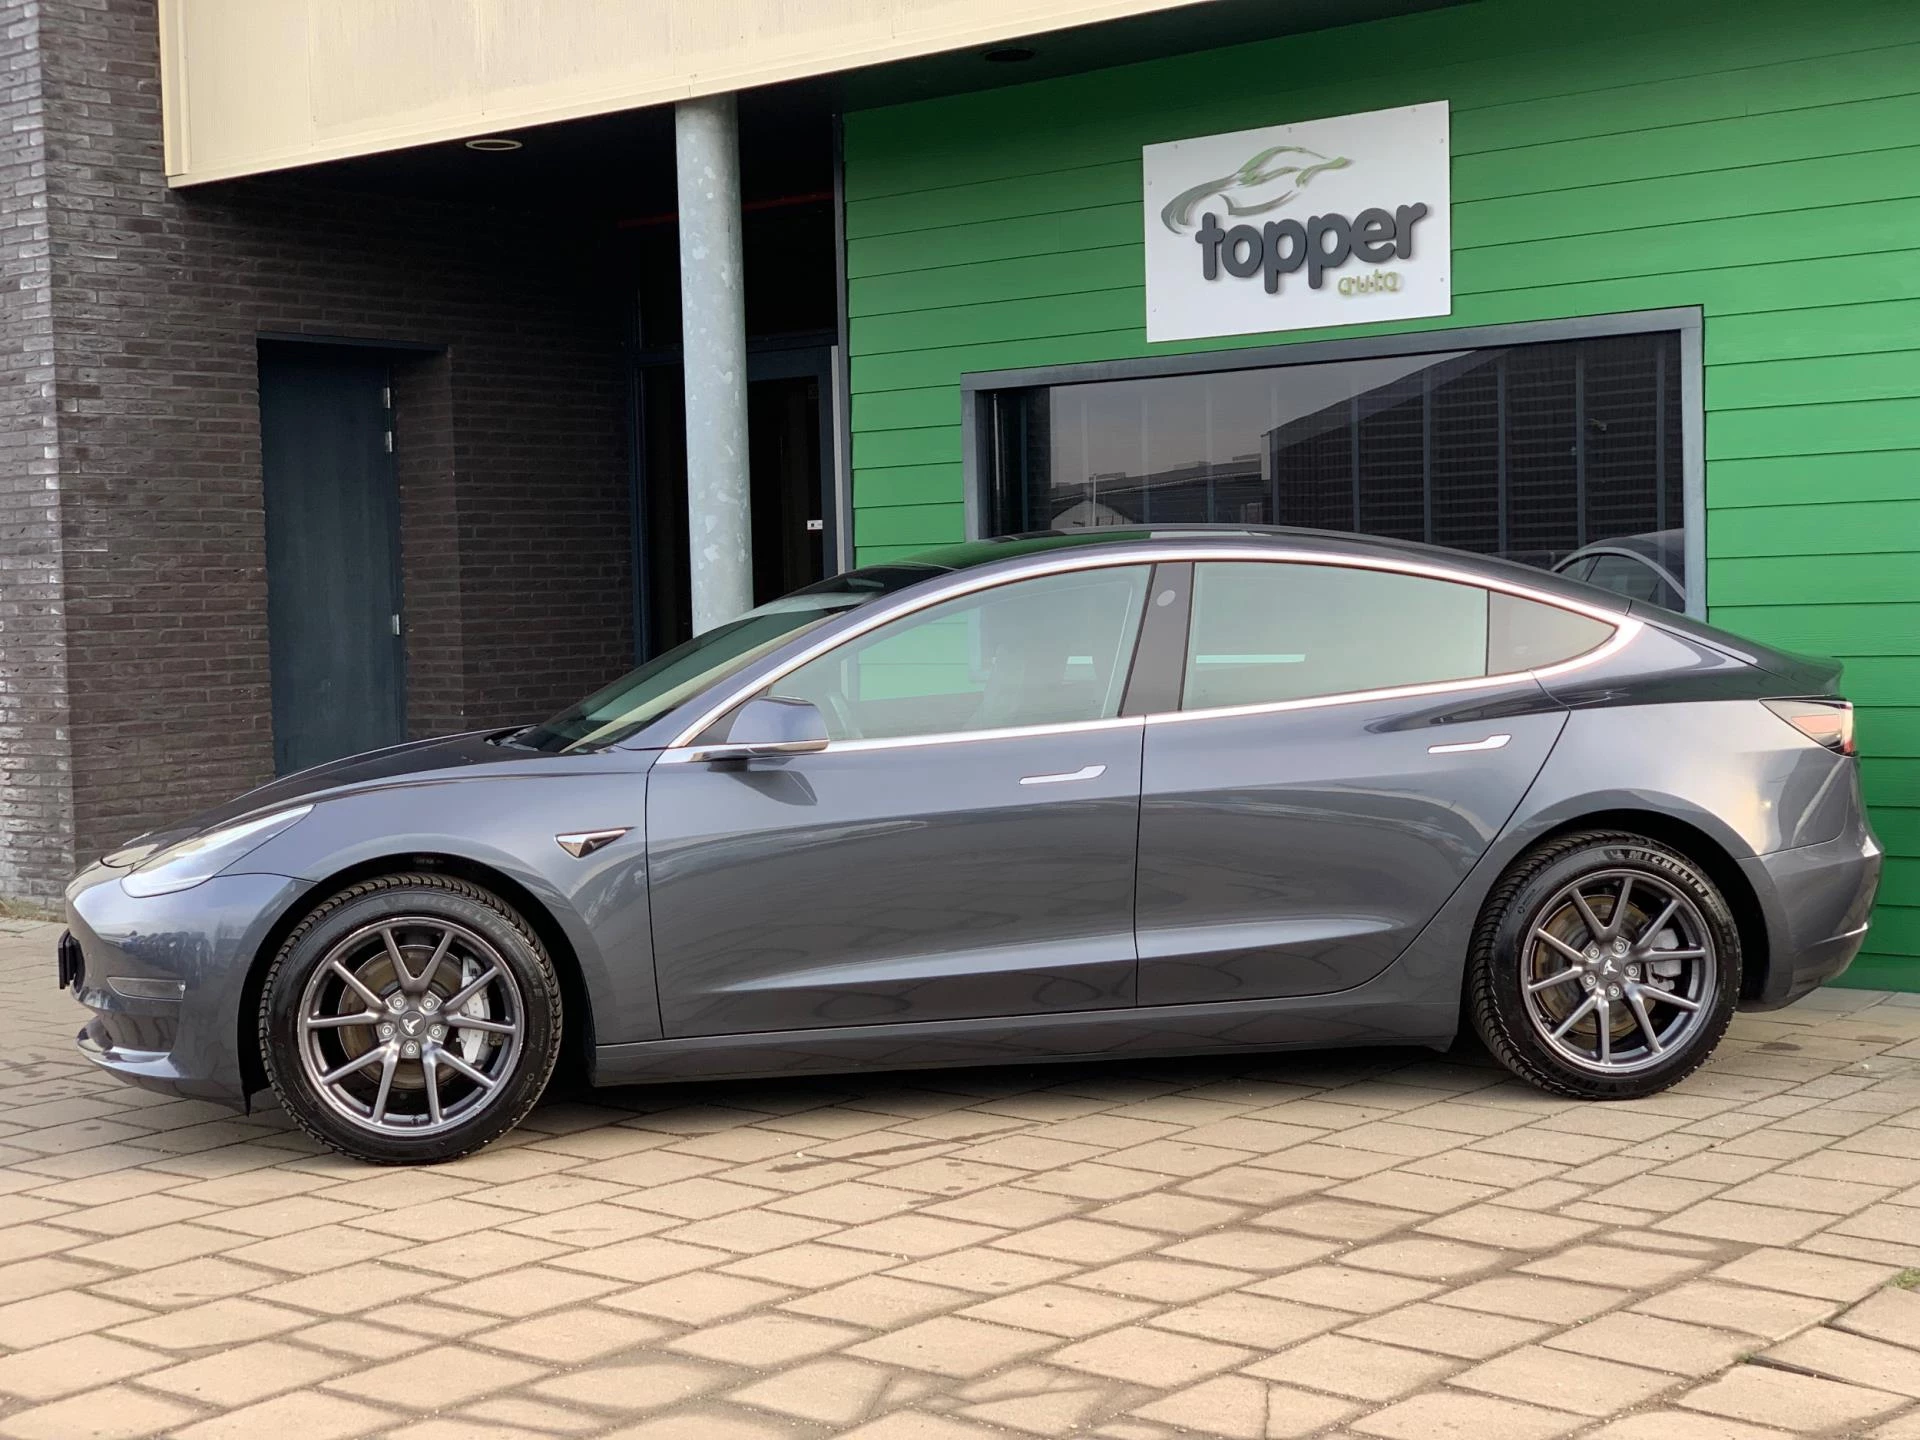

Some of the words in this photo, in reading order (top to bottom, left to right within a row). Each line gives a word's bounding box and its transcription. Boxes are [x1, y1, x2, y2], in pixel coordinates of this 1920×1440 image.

[1195, 202, 1428, 295] topper
[1628, 849, 1707, 896] MICHELIN
[413, 896, 503, 936] MICHELIN
